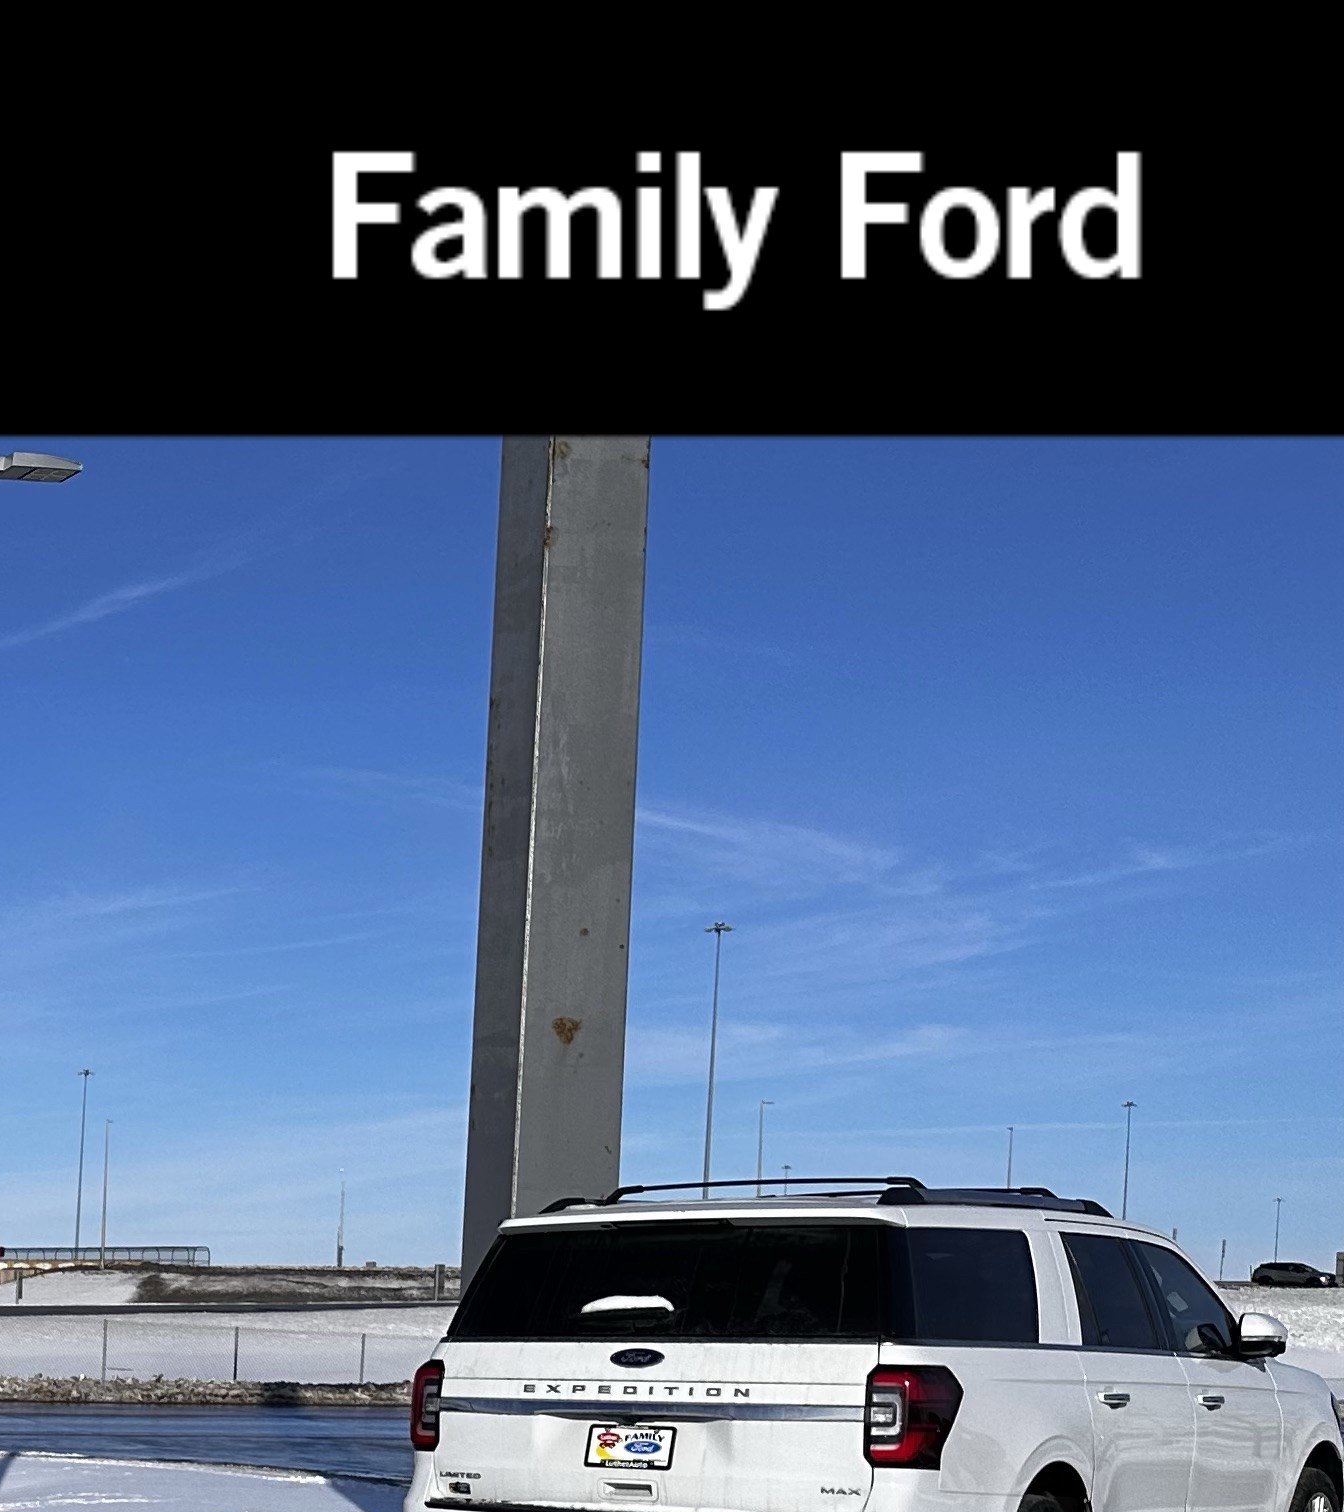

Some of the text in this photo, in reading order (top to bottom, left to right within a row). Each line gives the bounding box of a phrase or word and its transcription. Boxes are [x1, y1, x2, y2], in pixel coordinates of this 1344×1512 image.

[523, 1384, 750, 1398] EXPEDITION
[624, 1432, 665, 1442] FAMILY
[631, 1442, 655, 1452] Ford
[820, 1486, 862, 1497] MAX
